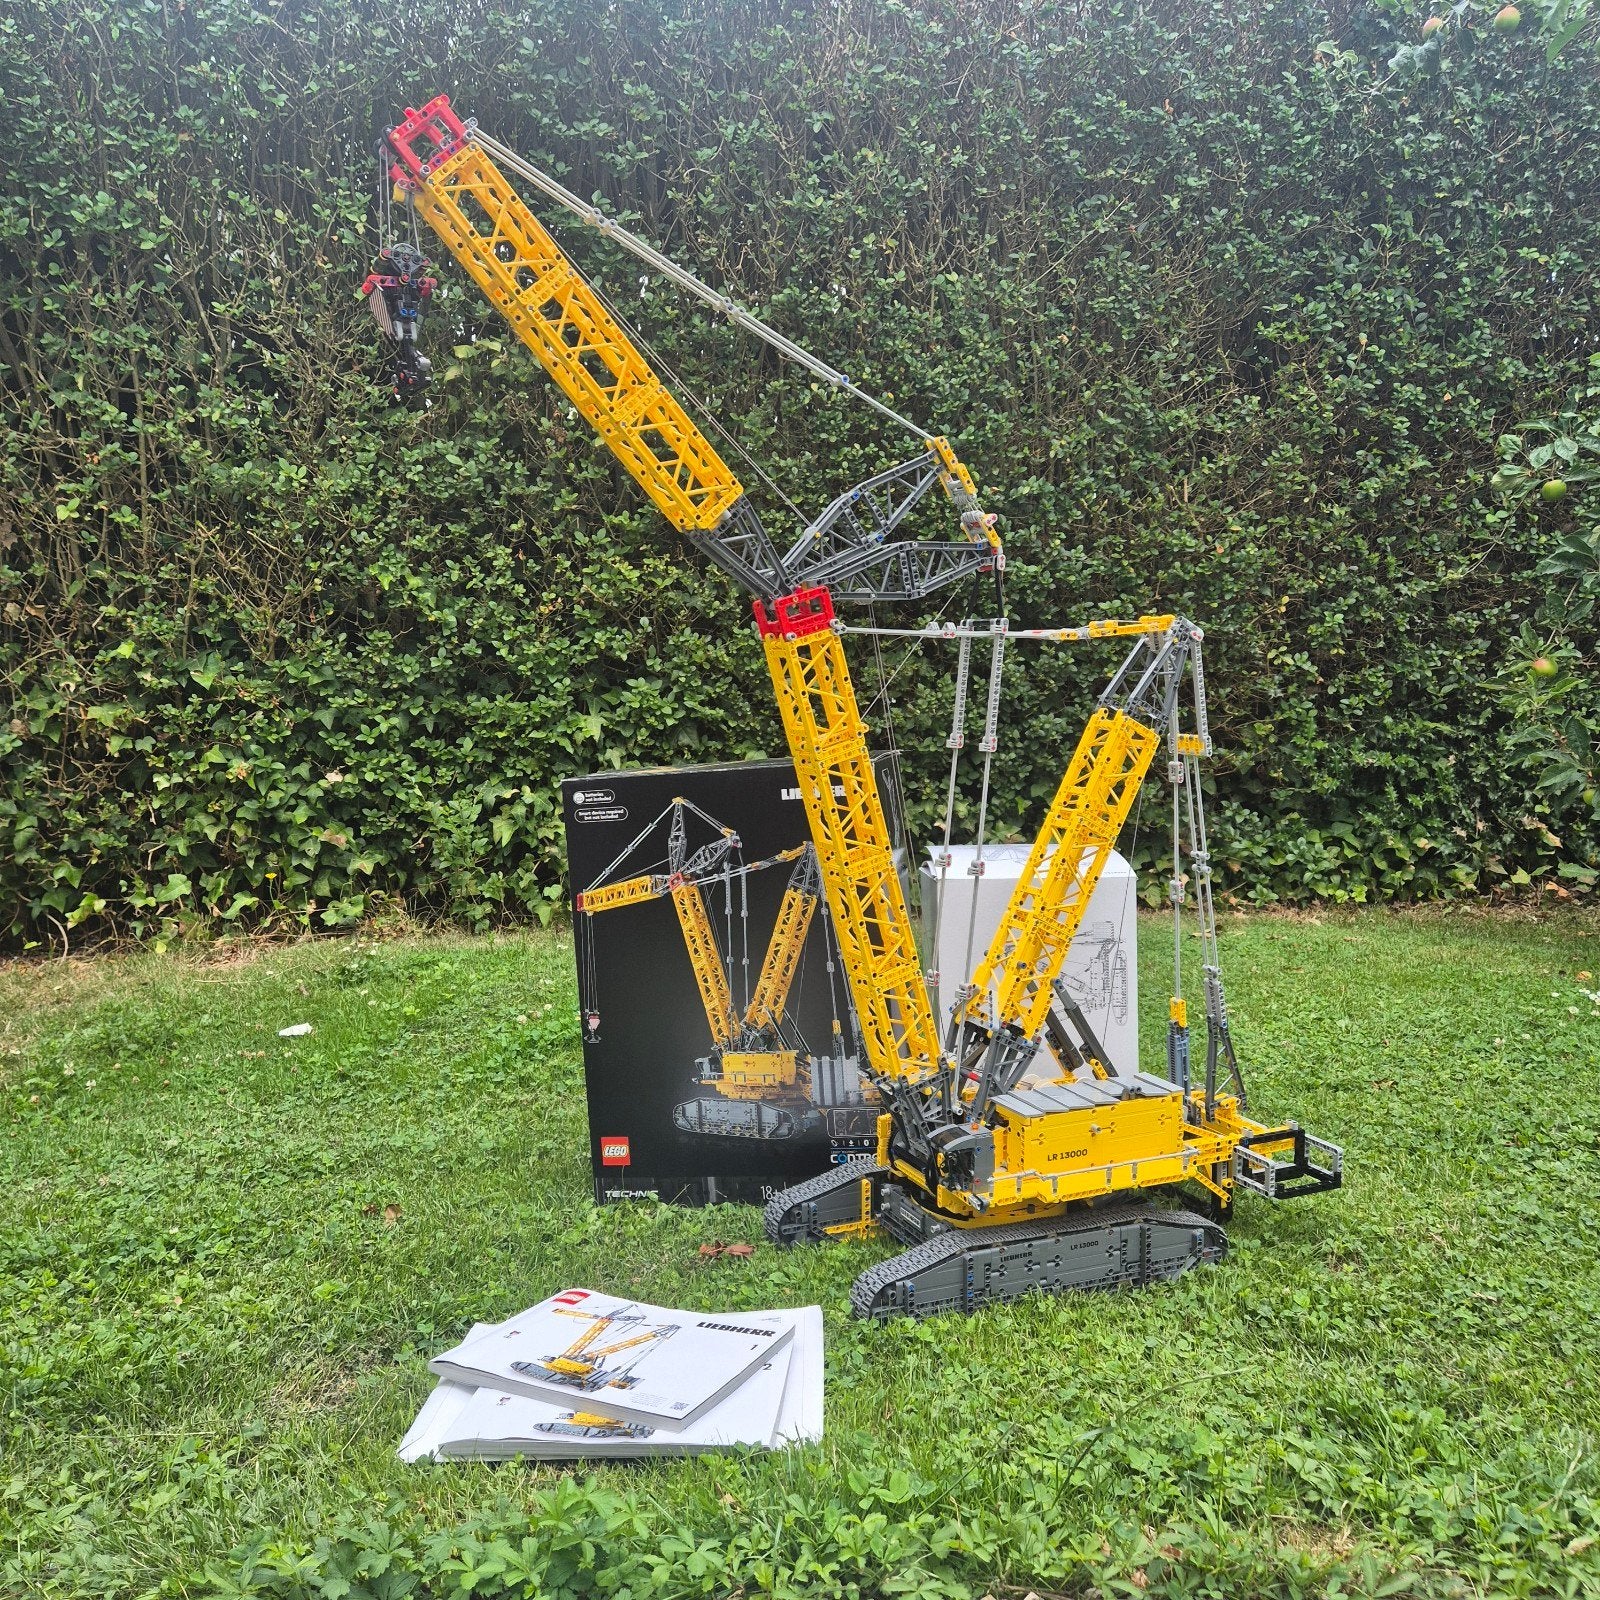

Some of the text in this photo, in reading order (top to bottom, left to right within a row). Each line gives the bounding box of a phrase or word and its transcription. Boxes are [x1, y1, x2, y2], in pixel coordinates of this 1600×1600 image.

[604, 1146, 627, 1156] LEGO
[1047, 1149, 1088, 1162] LR 13000
[1079, 1240, 1099, 1249] 13000
[1000, 1251, 1033, 1263] LIEBHERR
[696, 1321, 776, 1337] LIEBHERR
